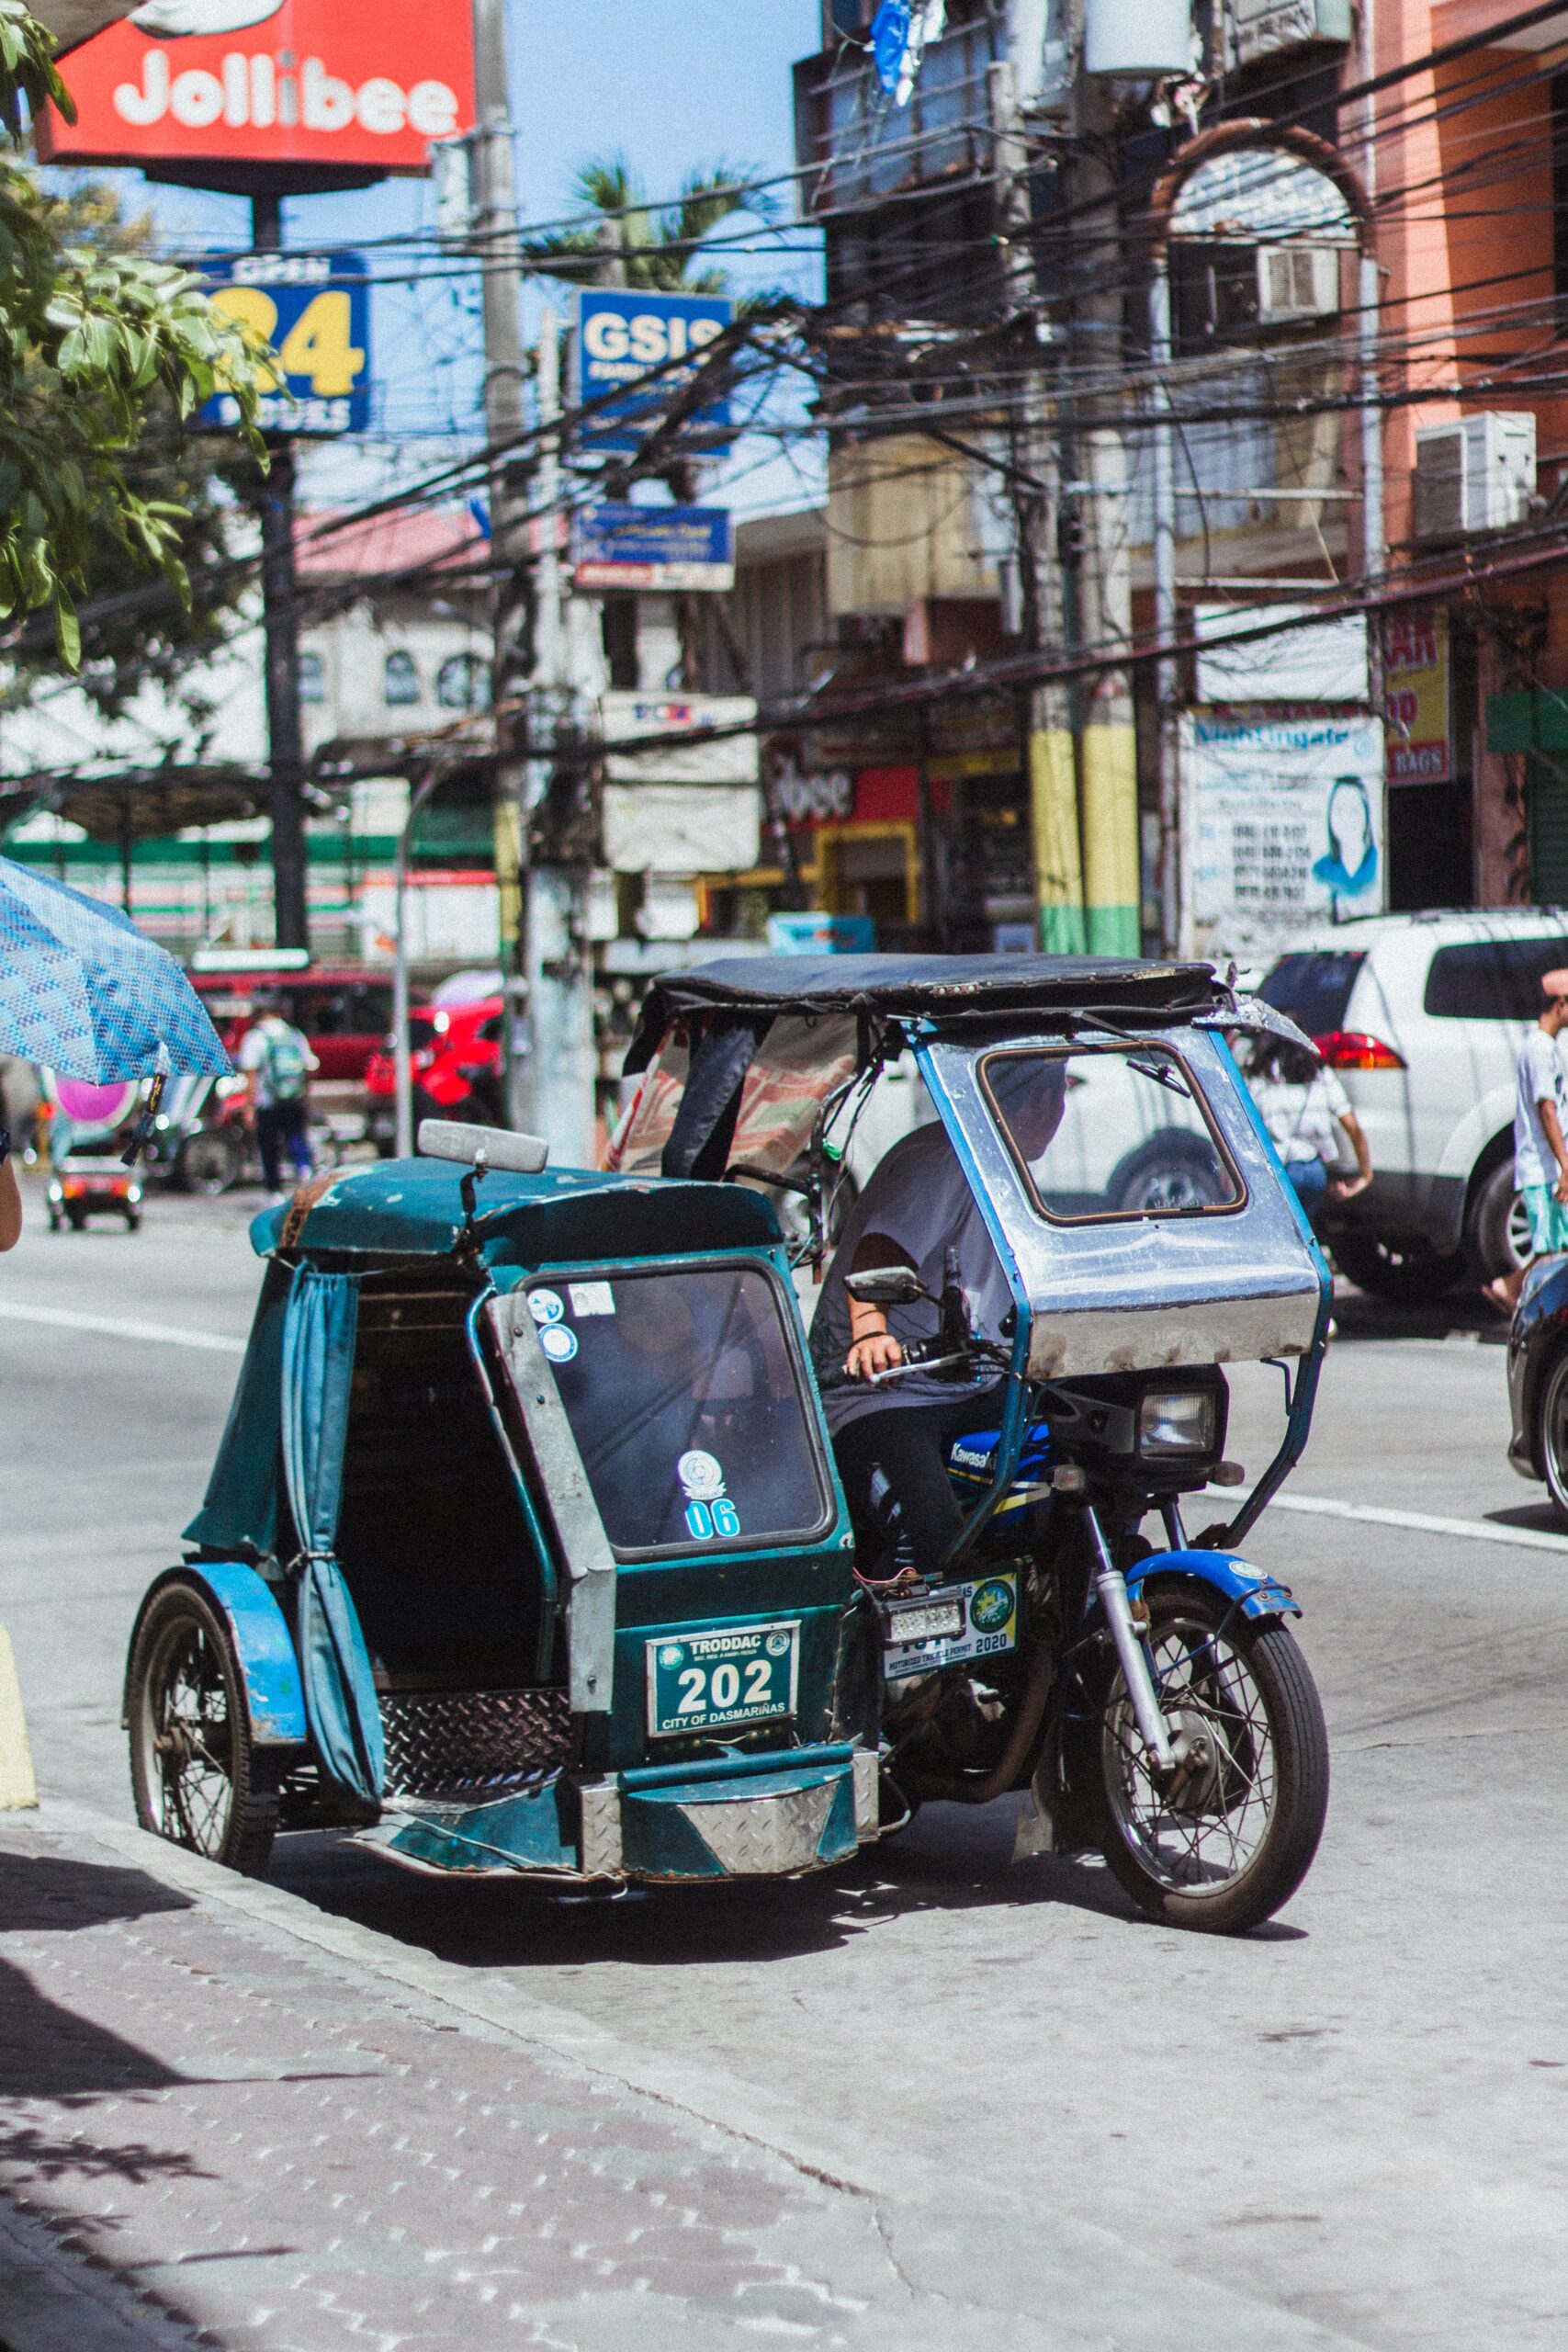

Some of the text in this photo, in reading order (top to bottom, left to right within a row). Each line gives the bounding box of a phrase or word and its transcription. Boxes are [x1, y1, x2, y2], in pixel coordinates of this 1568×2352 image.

[113, 49, 457, 135] Jollibee
[684, 1498, 741, 1540] 06
[689, 1635, 761, 1655] TRODDAC
[976, 1634, 1007, 1653] 2020
[677, 1659, 773, 1714] 202
[662, 1702, 785, 1730] CITY OF DASMARIÑAS
